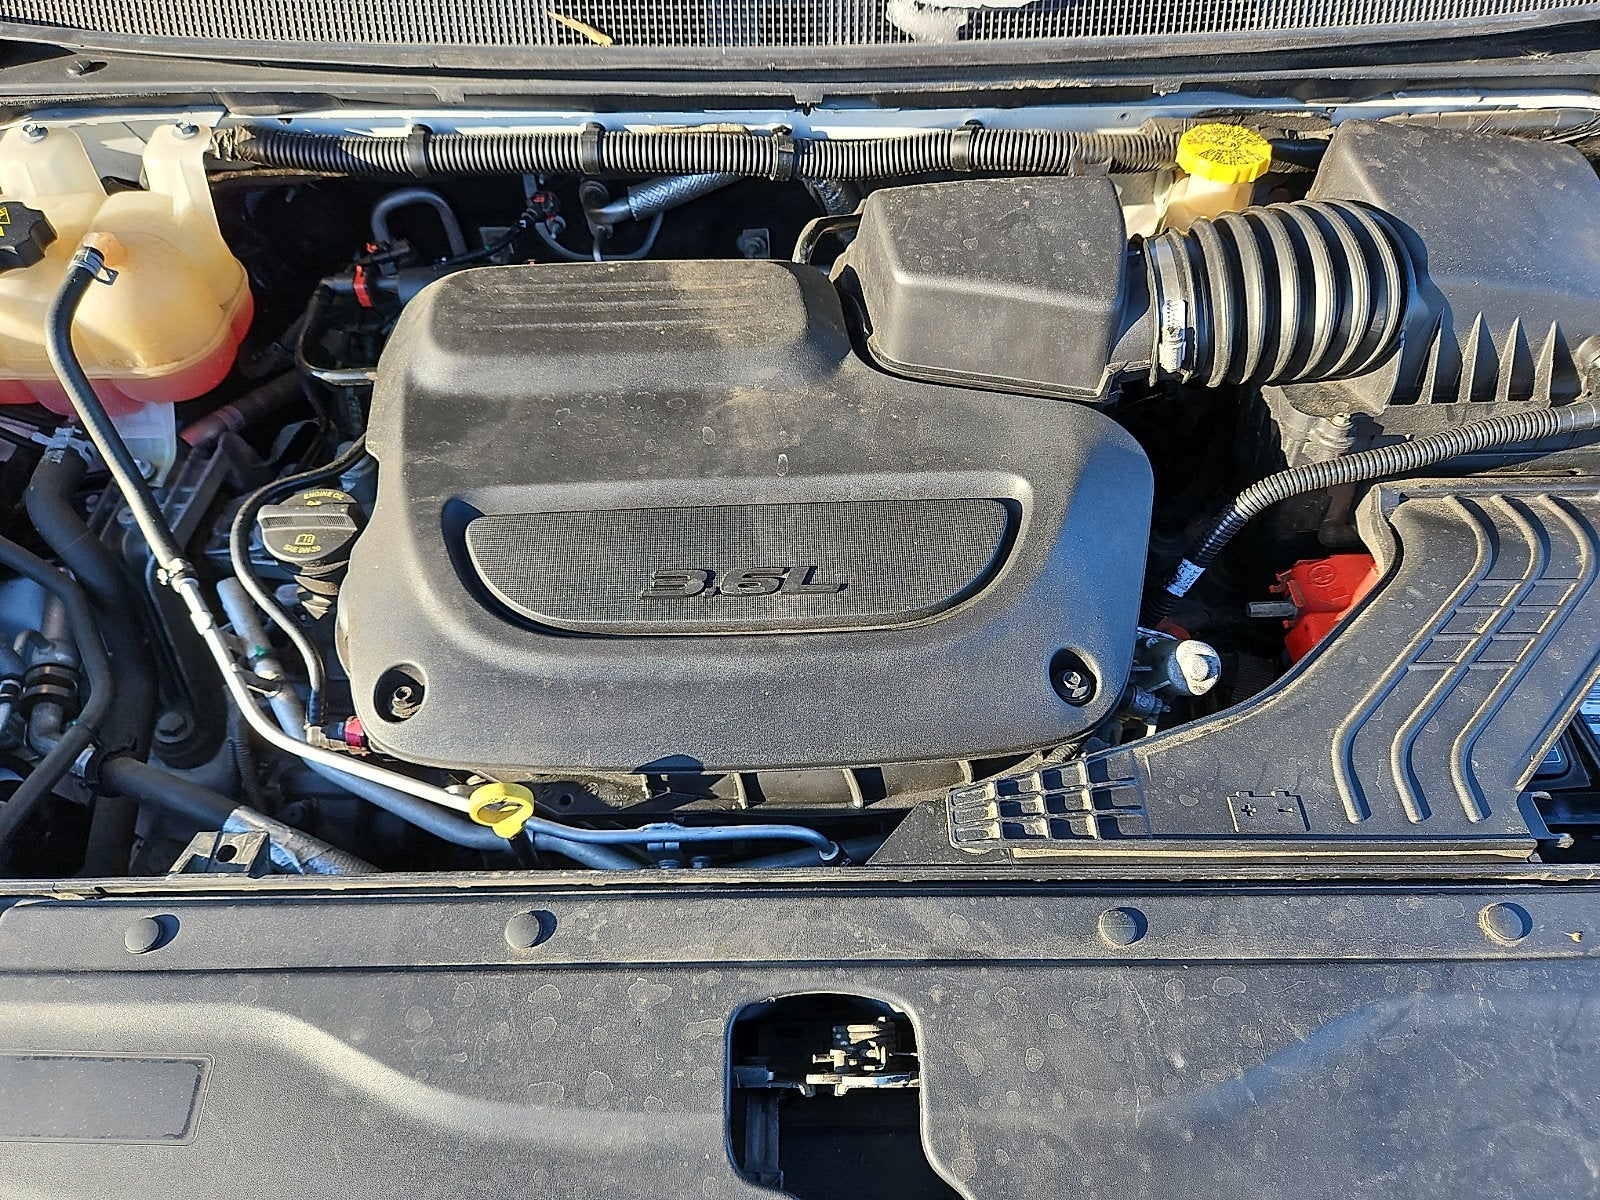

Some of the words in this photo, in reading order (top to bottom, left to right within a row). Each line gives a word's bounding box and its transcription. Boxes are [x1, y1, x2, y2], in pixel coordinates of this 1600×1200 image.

[303, 490, 334, 500] ENGINE
[333, 491, 345, 501] OIL
[283, 544, 298, 553] SAE
[641, 566, 845, 599] 3.6L
